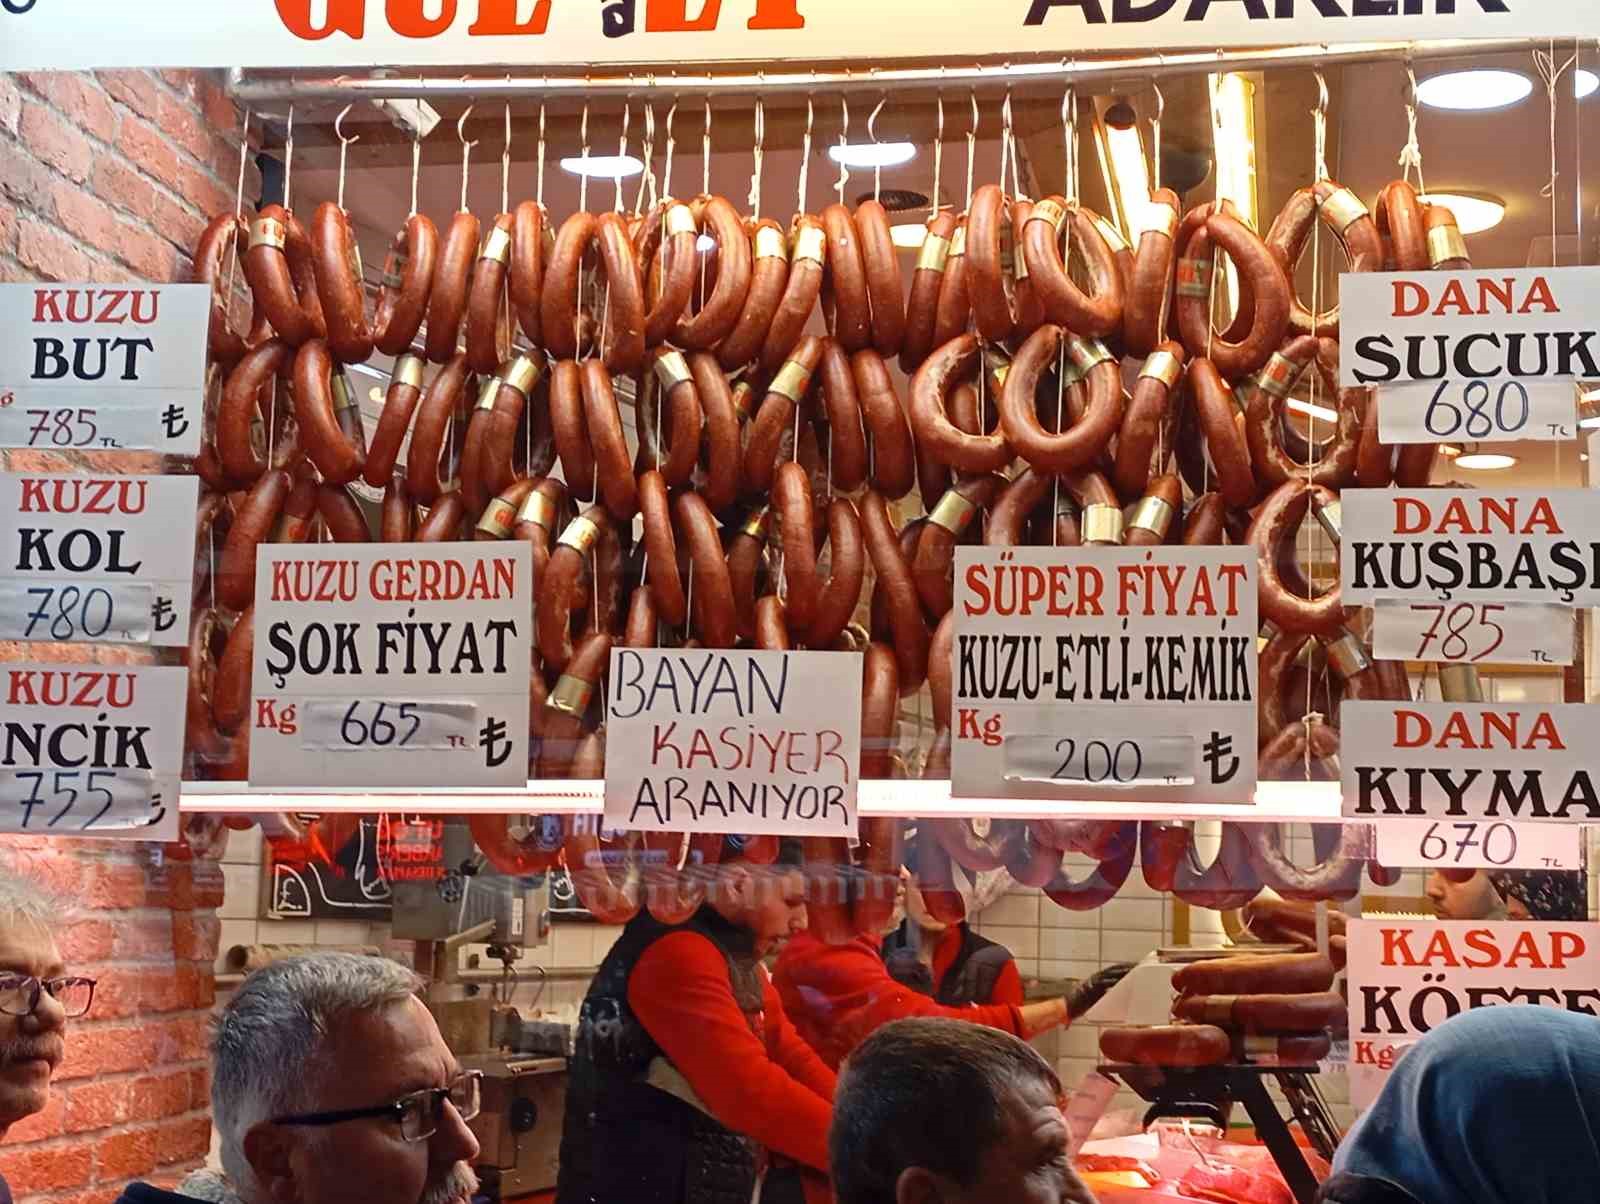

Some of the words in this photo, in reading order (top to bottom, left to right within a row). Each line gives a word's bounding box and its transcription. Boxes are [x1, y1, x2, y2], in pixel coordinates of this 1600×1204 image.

[33, 289, 162, 323] KUZU
[1391, 276, 1561, 317] DANA
[32, 337, 154, 380] BUT
[1352, 331, 1600, 384] SUCUK
[27, 408, 97, 447] 785
[1425, 379, 1529, 438] 680
[19, 479, 149, 514] KUZU
[1393, 497, 1563, 534] DANA
[16, 528, 141, 574] KOL
[270, 559, 359, 602] KUZU
[369, 558, 516, 603] GERDAN
[963, 551, 1104, 618] SÜPER
[1117, 551, 1247, 616] FİYAT
[24, 585, 113, 640] 780
[1410, 602, 1505, 661] 785
[266, 619, 362, 689] ŞOK
[376, 608, 518, 675] FİYAT
[958, 617, 1251, 703] KUZU-ETLİ-KEMİK
[7, 671, 137, 708] KUZU
[611, 650, 789, 718] BAYAN
[0, 713, 152, 769] NCİK
[256, 699, 296, 735] Kg
[340, 700, 421, 746] 665
[958, 708, 1002, 746] Kg
[1050, 738, 1142, 783] 200
[1393, 710, 1566, 749] DANA
[651, 720, 849, 784] KASİYER
[15, 772, 117, 830] 755
[629, 776, 849, 826] ARANIYOR
[1354, 766, 1600, 818] KIYMA
[1420, 822, 1517, 865] 670
[1380, 928, 1586, 969] KASAP
[1355, 1040, 1393, 1069] Kg
